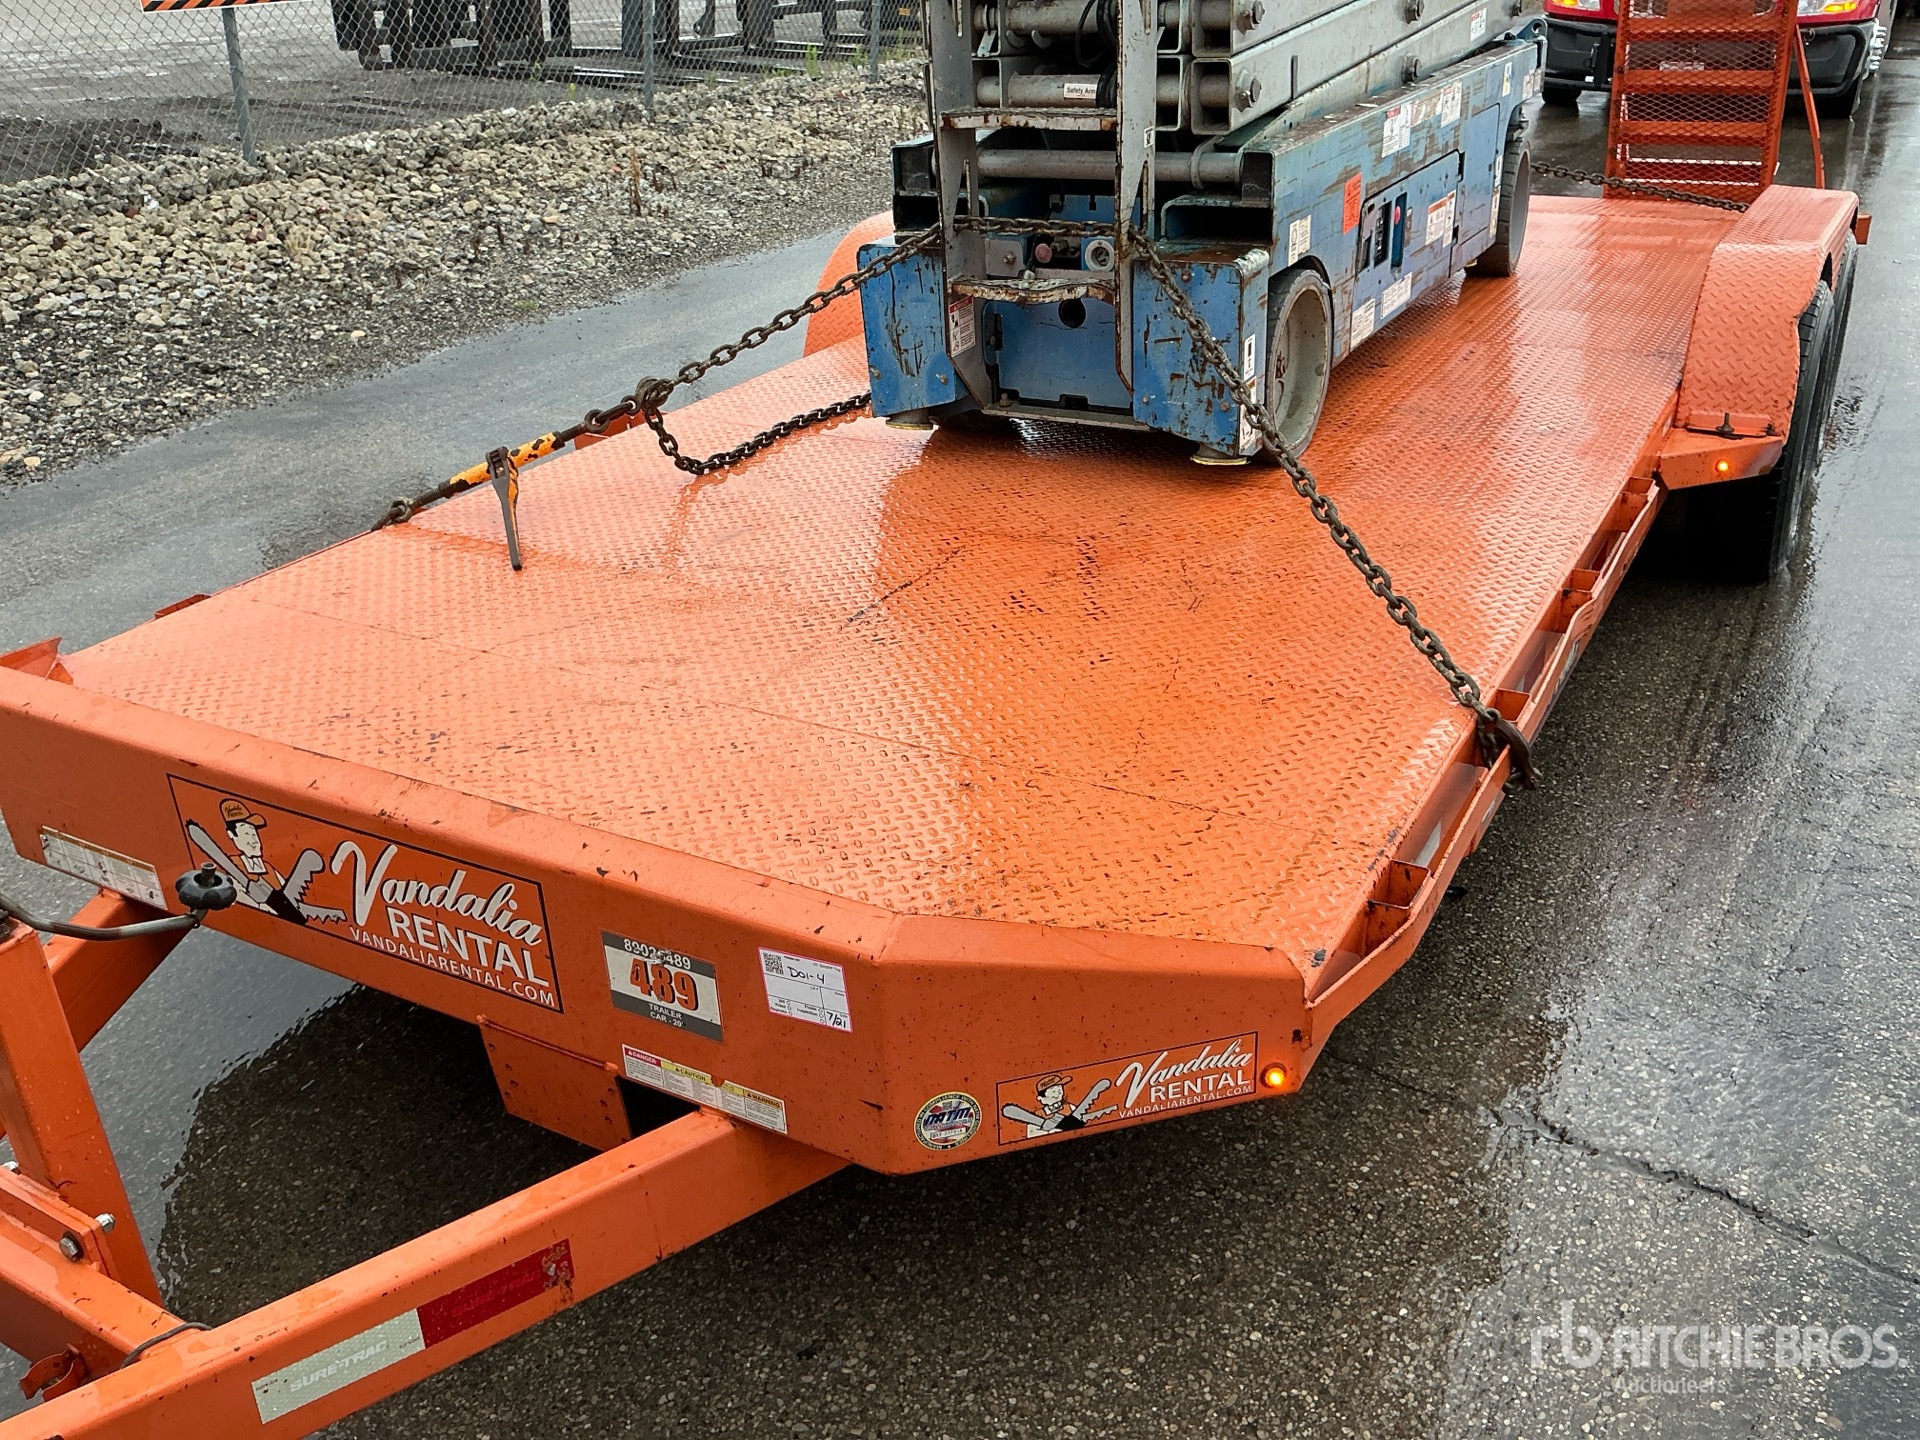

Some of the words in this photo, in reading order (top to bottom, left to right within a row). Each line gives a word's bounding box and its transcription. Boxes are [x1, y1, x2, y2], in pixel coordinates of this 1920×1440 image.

[1066, 87, 1083, 95] Safety
[331, 840, 543, 947] Vandalia
[386, 906, 549, 988] RENTAL
[349, 926, 555, 1007] VANDALIARENTAL.COM
[629, 957, 699, 1011] 489
[648, 1004, 682, 1020] TRAILER
[650, 1011, 668, 1023] CAR
[632, 1050, 657, 1064] DANGER
[1114, 1038, 1253, 1109] Vandalia
[680, 1068, 706, 1082] CAUTION
[1150, 1069, 1251, 1103] RENTAL
[751, 1093, 780, 1109] WARNING
[1119, 1085, 1252, 1119] VANDALIARENTAL.COM
[290, 1339, 389, 1393] SURE-TRAC
